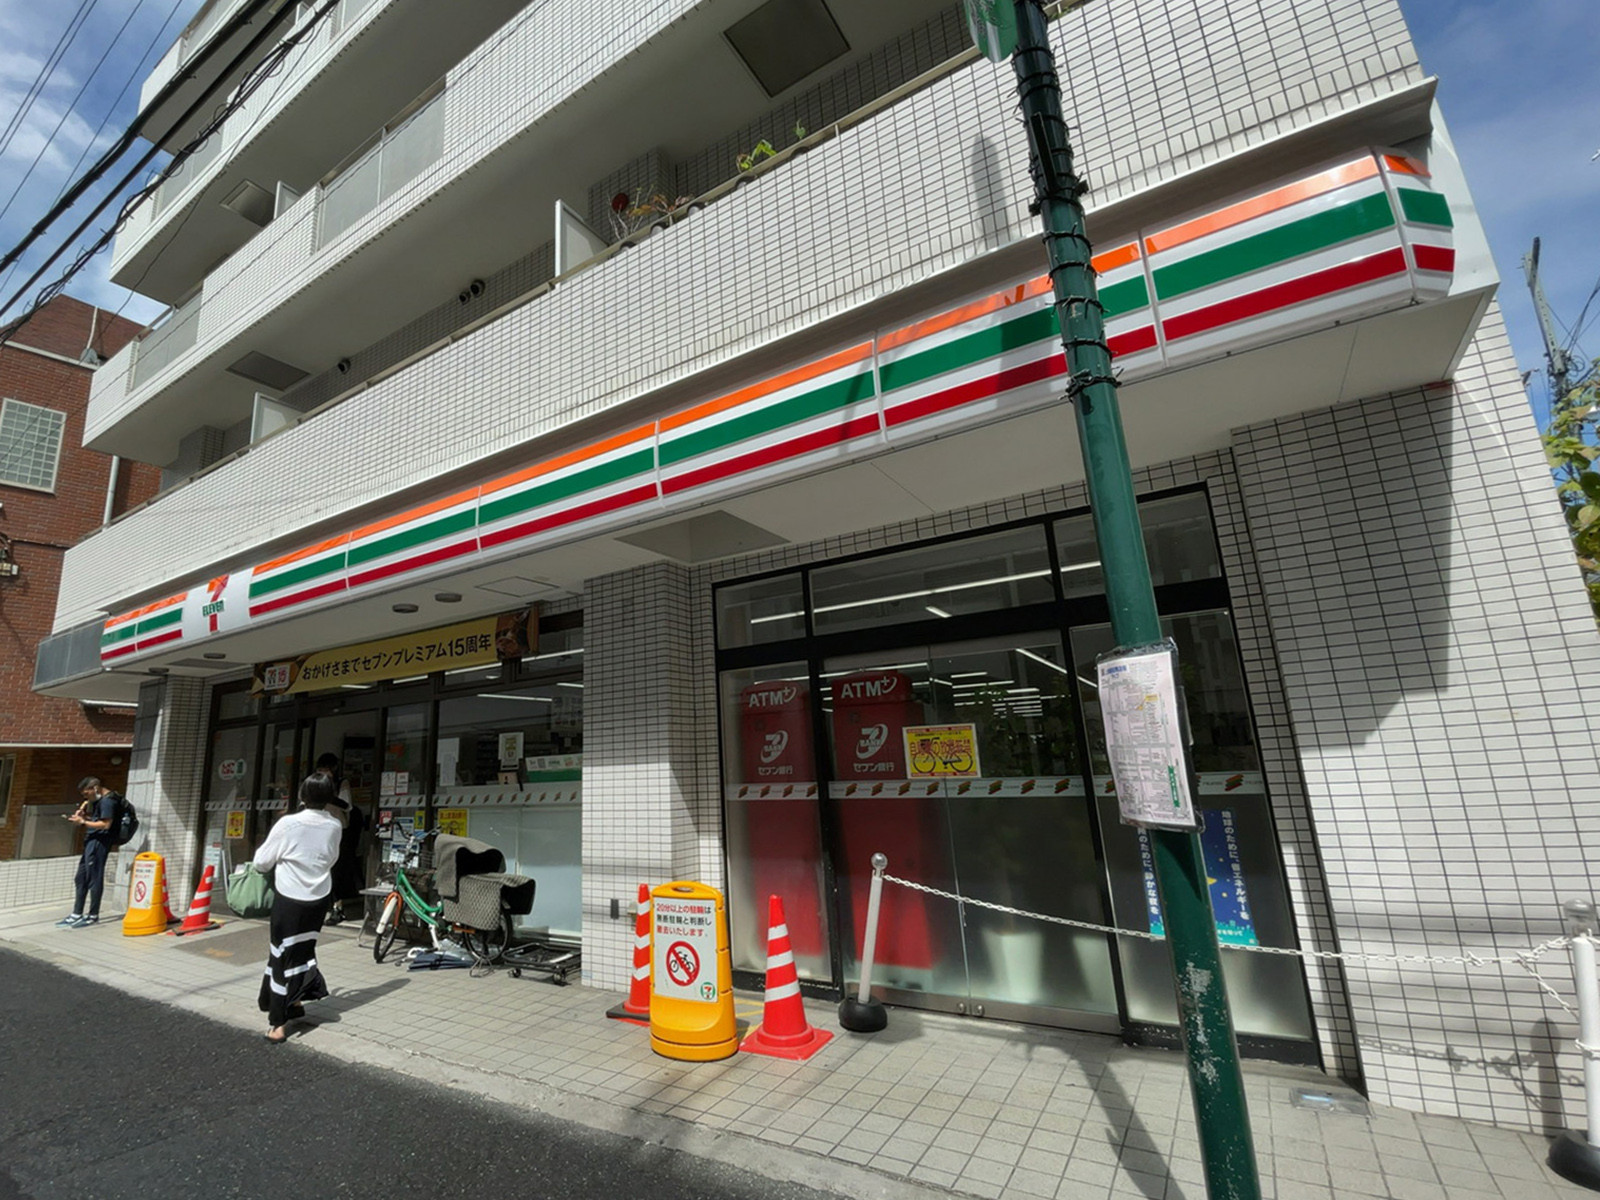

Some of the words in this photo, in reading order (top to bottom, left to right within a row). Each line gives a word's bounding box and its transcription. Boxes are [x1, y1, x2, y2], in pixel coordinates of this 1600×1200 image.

[302, 633, 492, 681] おかげさまでセブンプレミアム15周年
[757, 765, 793, 776] セブン銀行
[853, 762, 894, 772] セブン銀行
[656, 903, 711, 914] 20分以上の駐輪は
[656, 914, 712, 926] 無断駐輪と判断し
